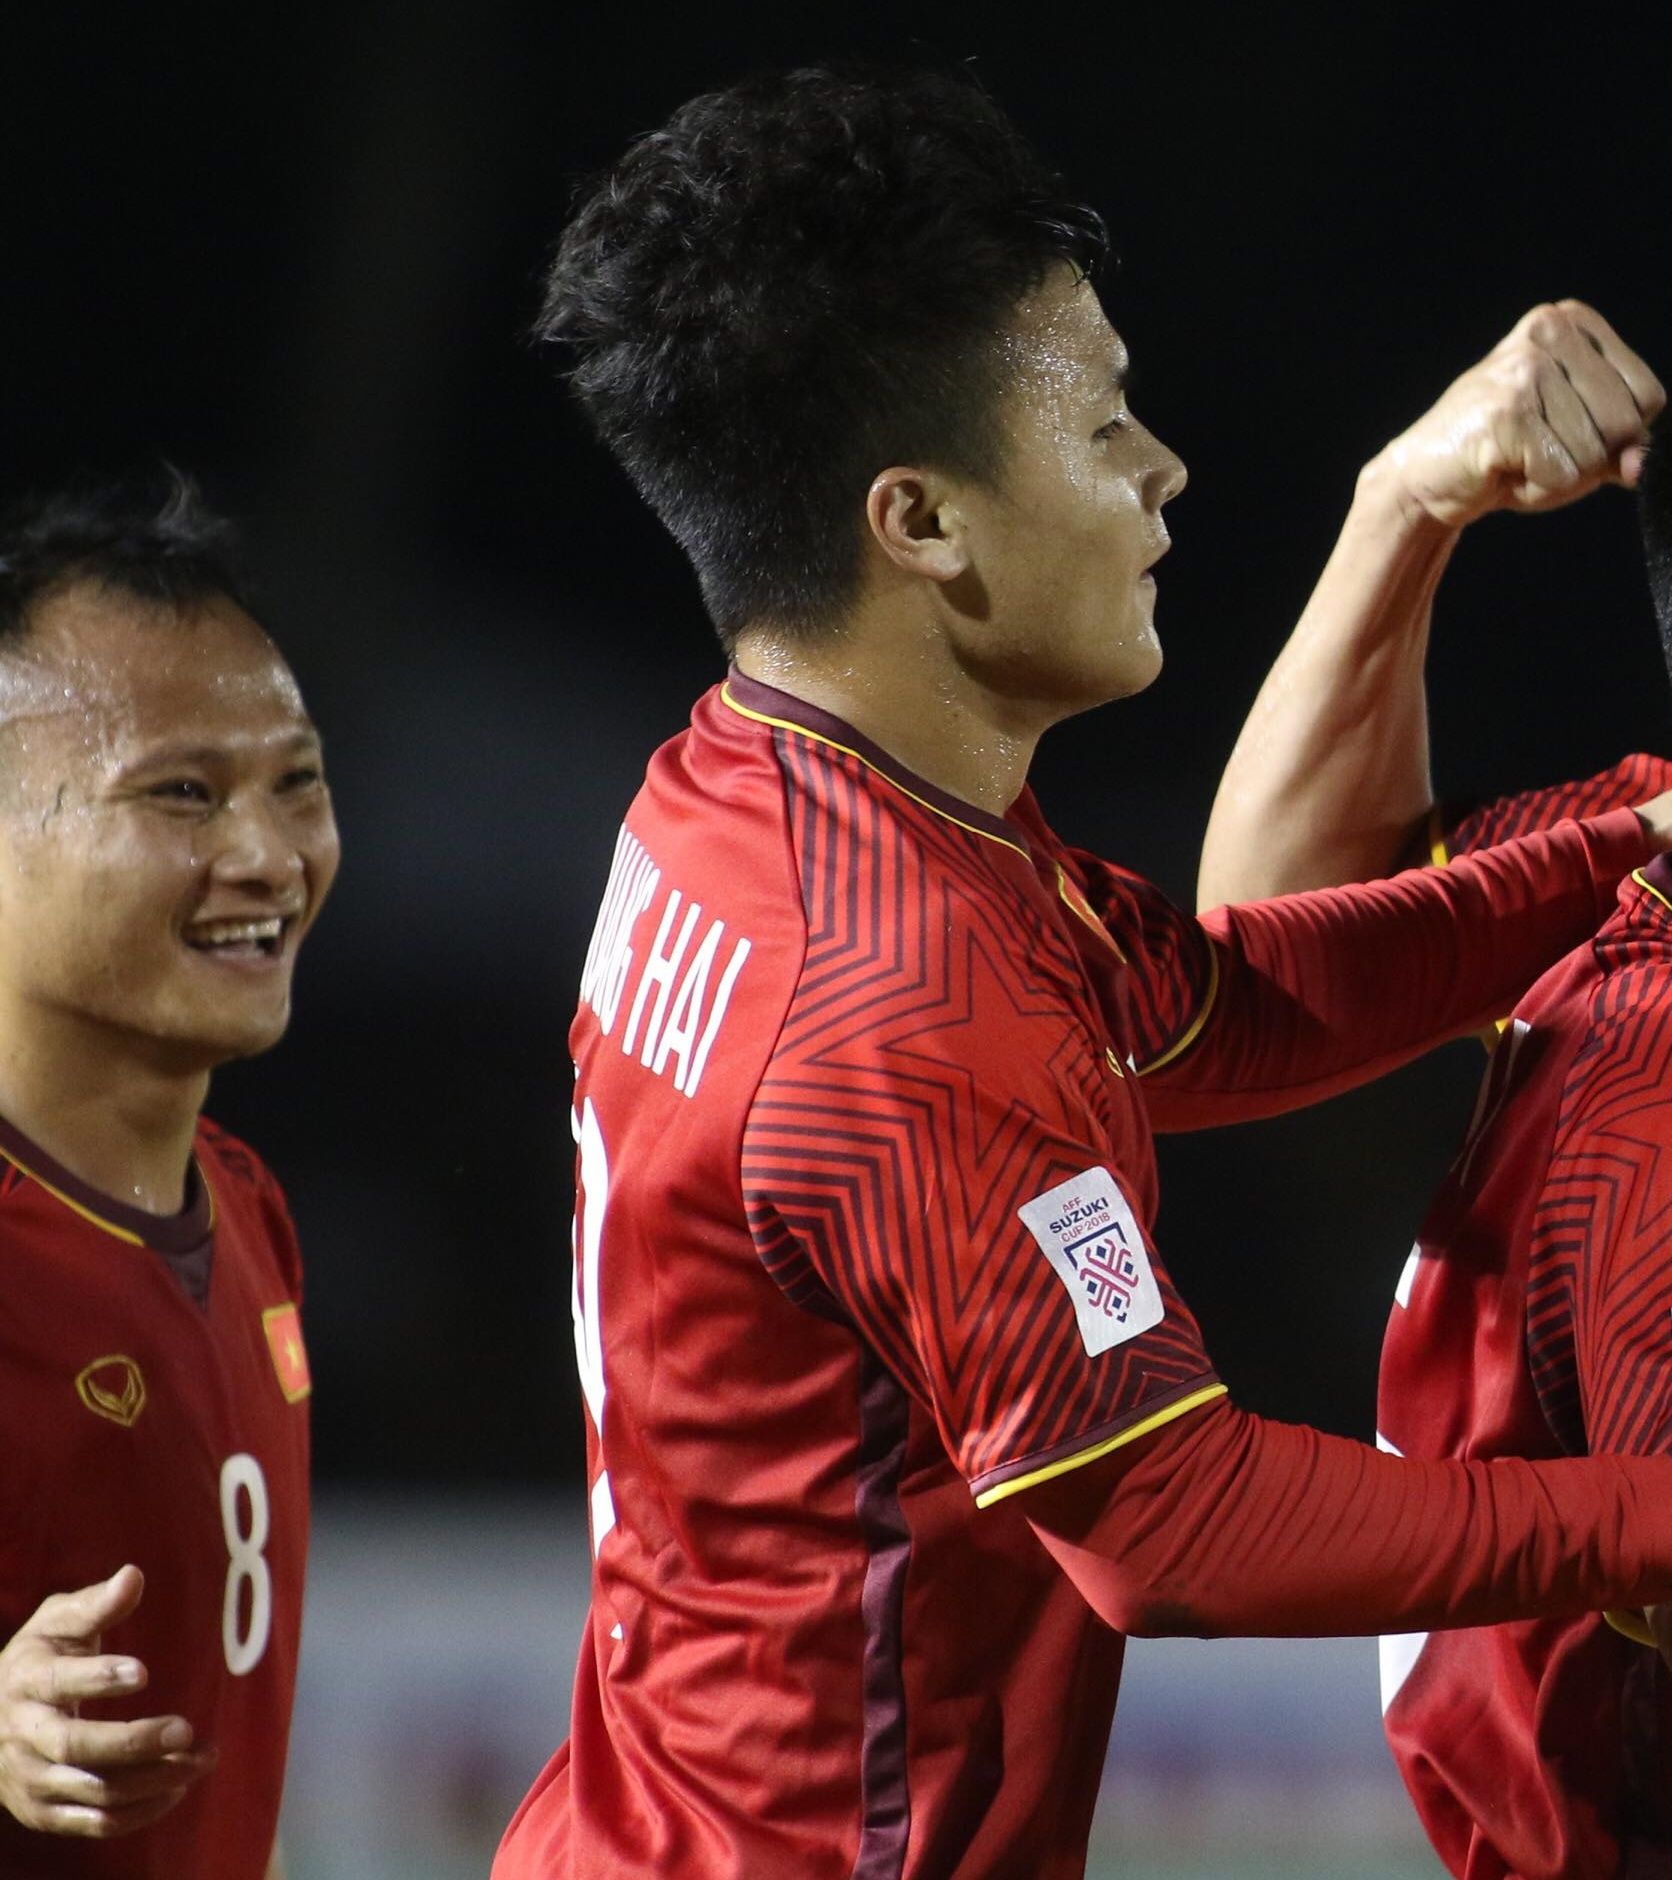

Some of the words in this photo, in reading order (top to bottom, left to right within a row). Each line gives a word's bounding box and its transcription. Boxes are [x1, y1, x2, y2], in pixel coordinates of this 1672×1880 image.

[622, 888, 751, 1099] HAI
[1049, 1197, 1109, 1233] SUZUKI
[1062, 1196, 1081, 1213] AFF
[1061, 1224, 1083, 1242] CUP
[1084, 1212, 1111, 1230] 2018
[219, 1452, 272, 1676] 8
